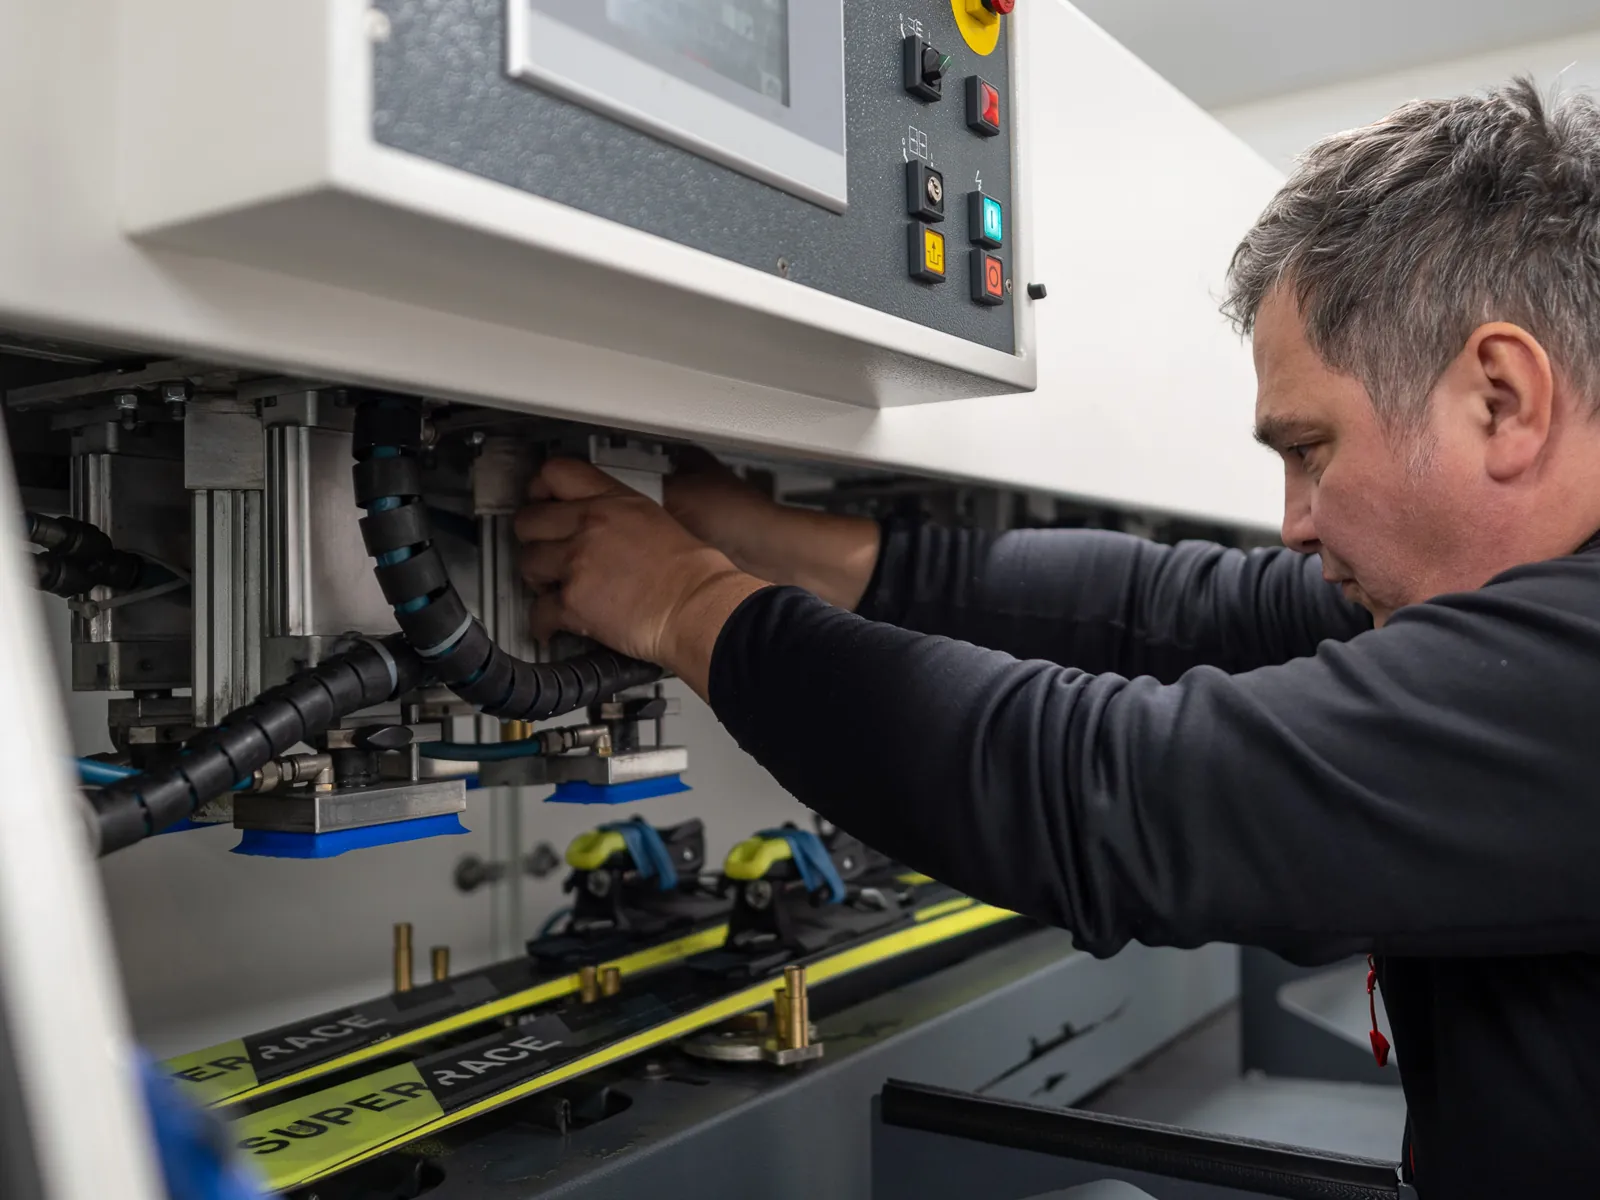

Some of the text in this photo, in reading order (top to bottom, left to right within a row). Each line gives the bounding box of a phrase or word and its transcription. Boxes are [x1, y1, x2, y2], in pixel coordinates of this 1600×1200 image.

[258, 1013, 388, 1060] RACE
[237, 1035, 563, 1155] SUPER RACE
